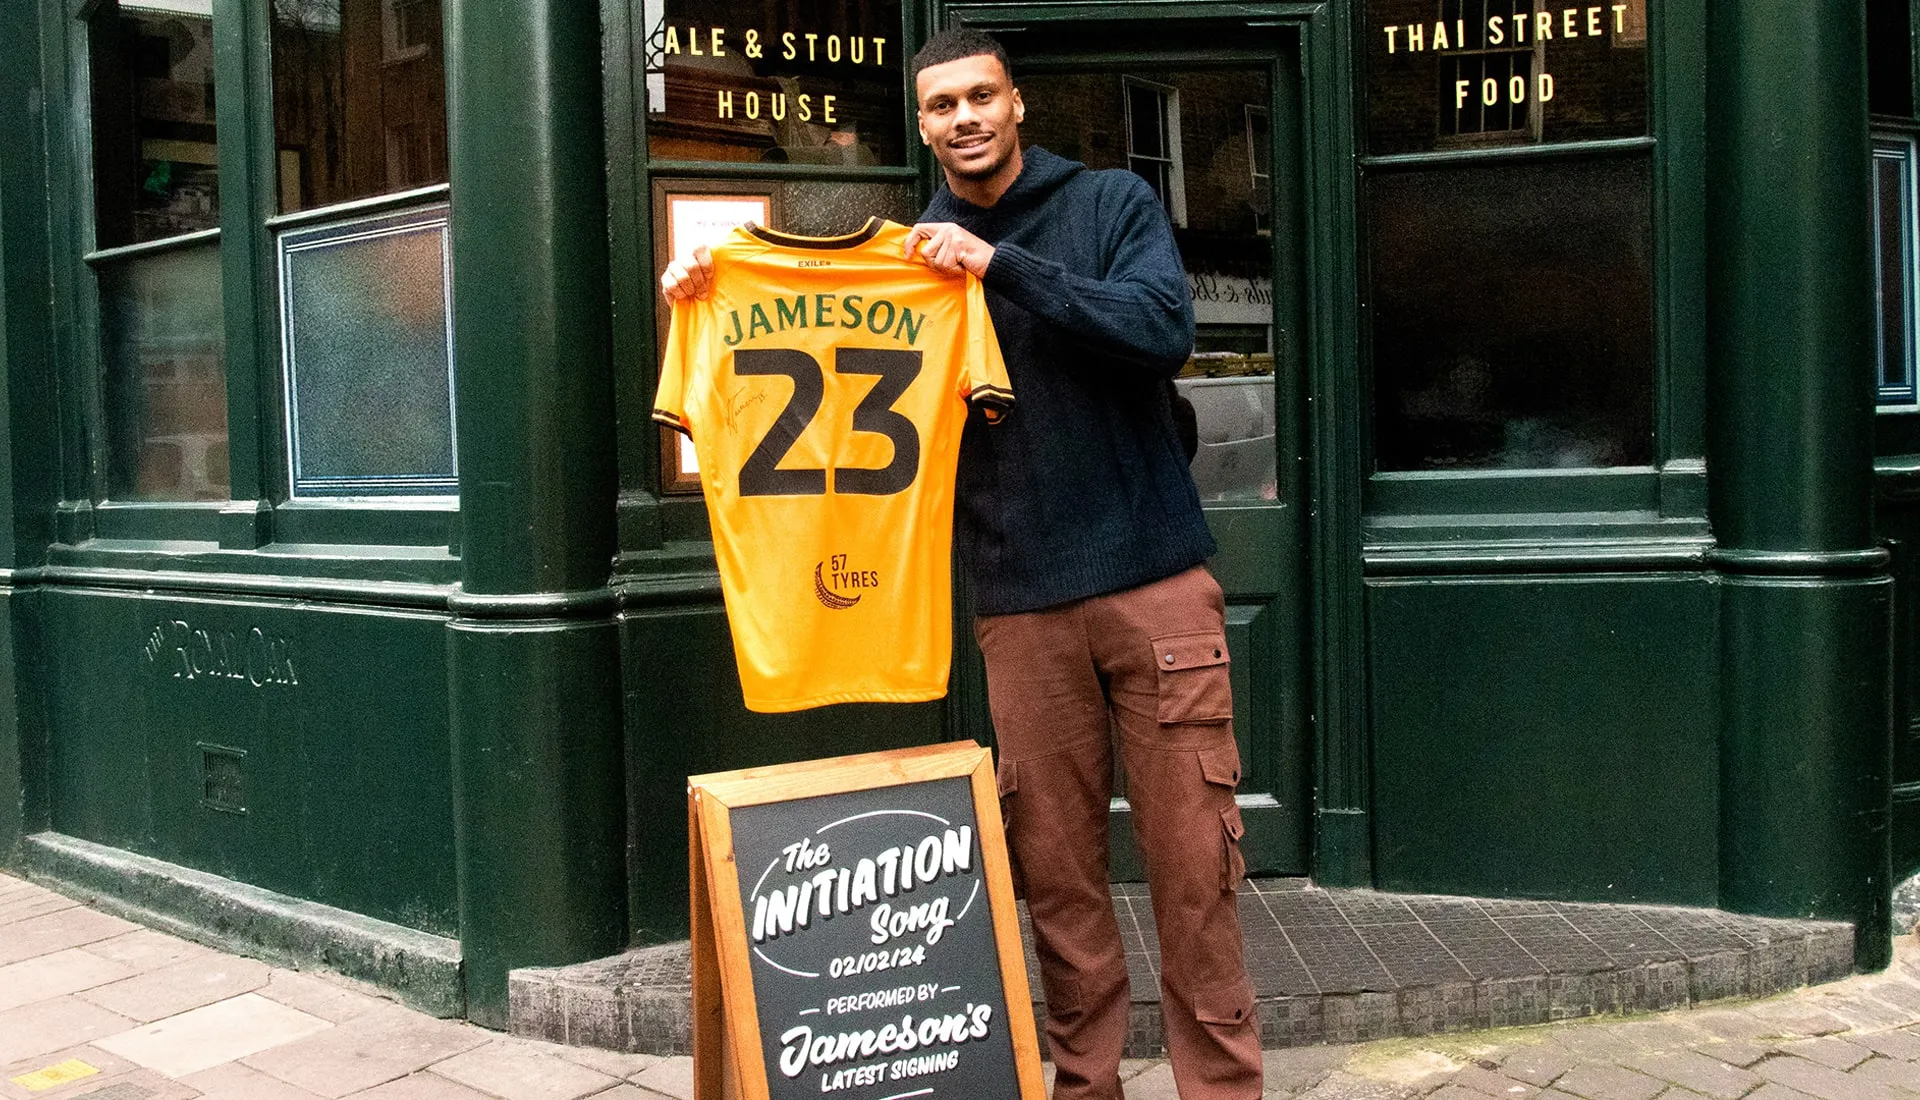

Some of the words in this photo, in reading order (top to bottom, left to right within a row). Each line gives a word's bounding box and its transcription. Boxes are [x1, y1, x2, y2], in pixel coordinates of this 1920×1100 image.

[664, 26, 726, 57] ALE
[745, 28, 763, 59] &
[782, 31, 886, 65] STOUT
[1384, 19, 1464, 54] THAI
[1489, 5, 1627, 45] STREET
[718, 90, 837, 123] HOUSE
[1456, 73, 1554, 109] FOOD
[723, 293, 927, 347] JAMESON
[733, 347, 923, 498] 23
[831, 553, 847, 571] 57
[831, 570, 879, 590] TYRES
[782, 837, 831, 873] The
[752, 825, 972, 941] INITIATION
[870, 896, 955, 945] Song
[829, 944, 926, 979] 02/02/24
[827, 986, 915, 1016] PERFORMED
[917, 983, 939, 1001] BY
[779, 1003, 992, 1077] Jameson's
[820, 1062, 889, 1093] LATEST
[890, 1050, 959, 1080] SIGNING
